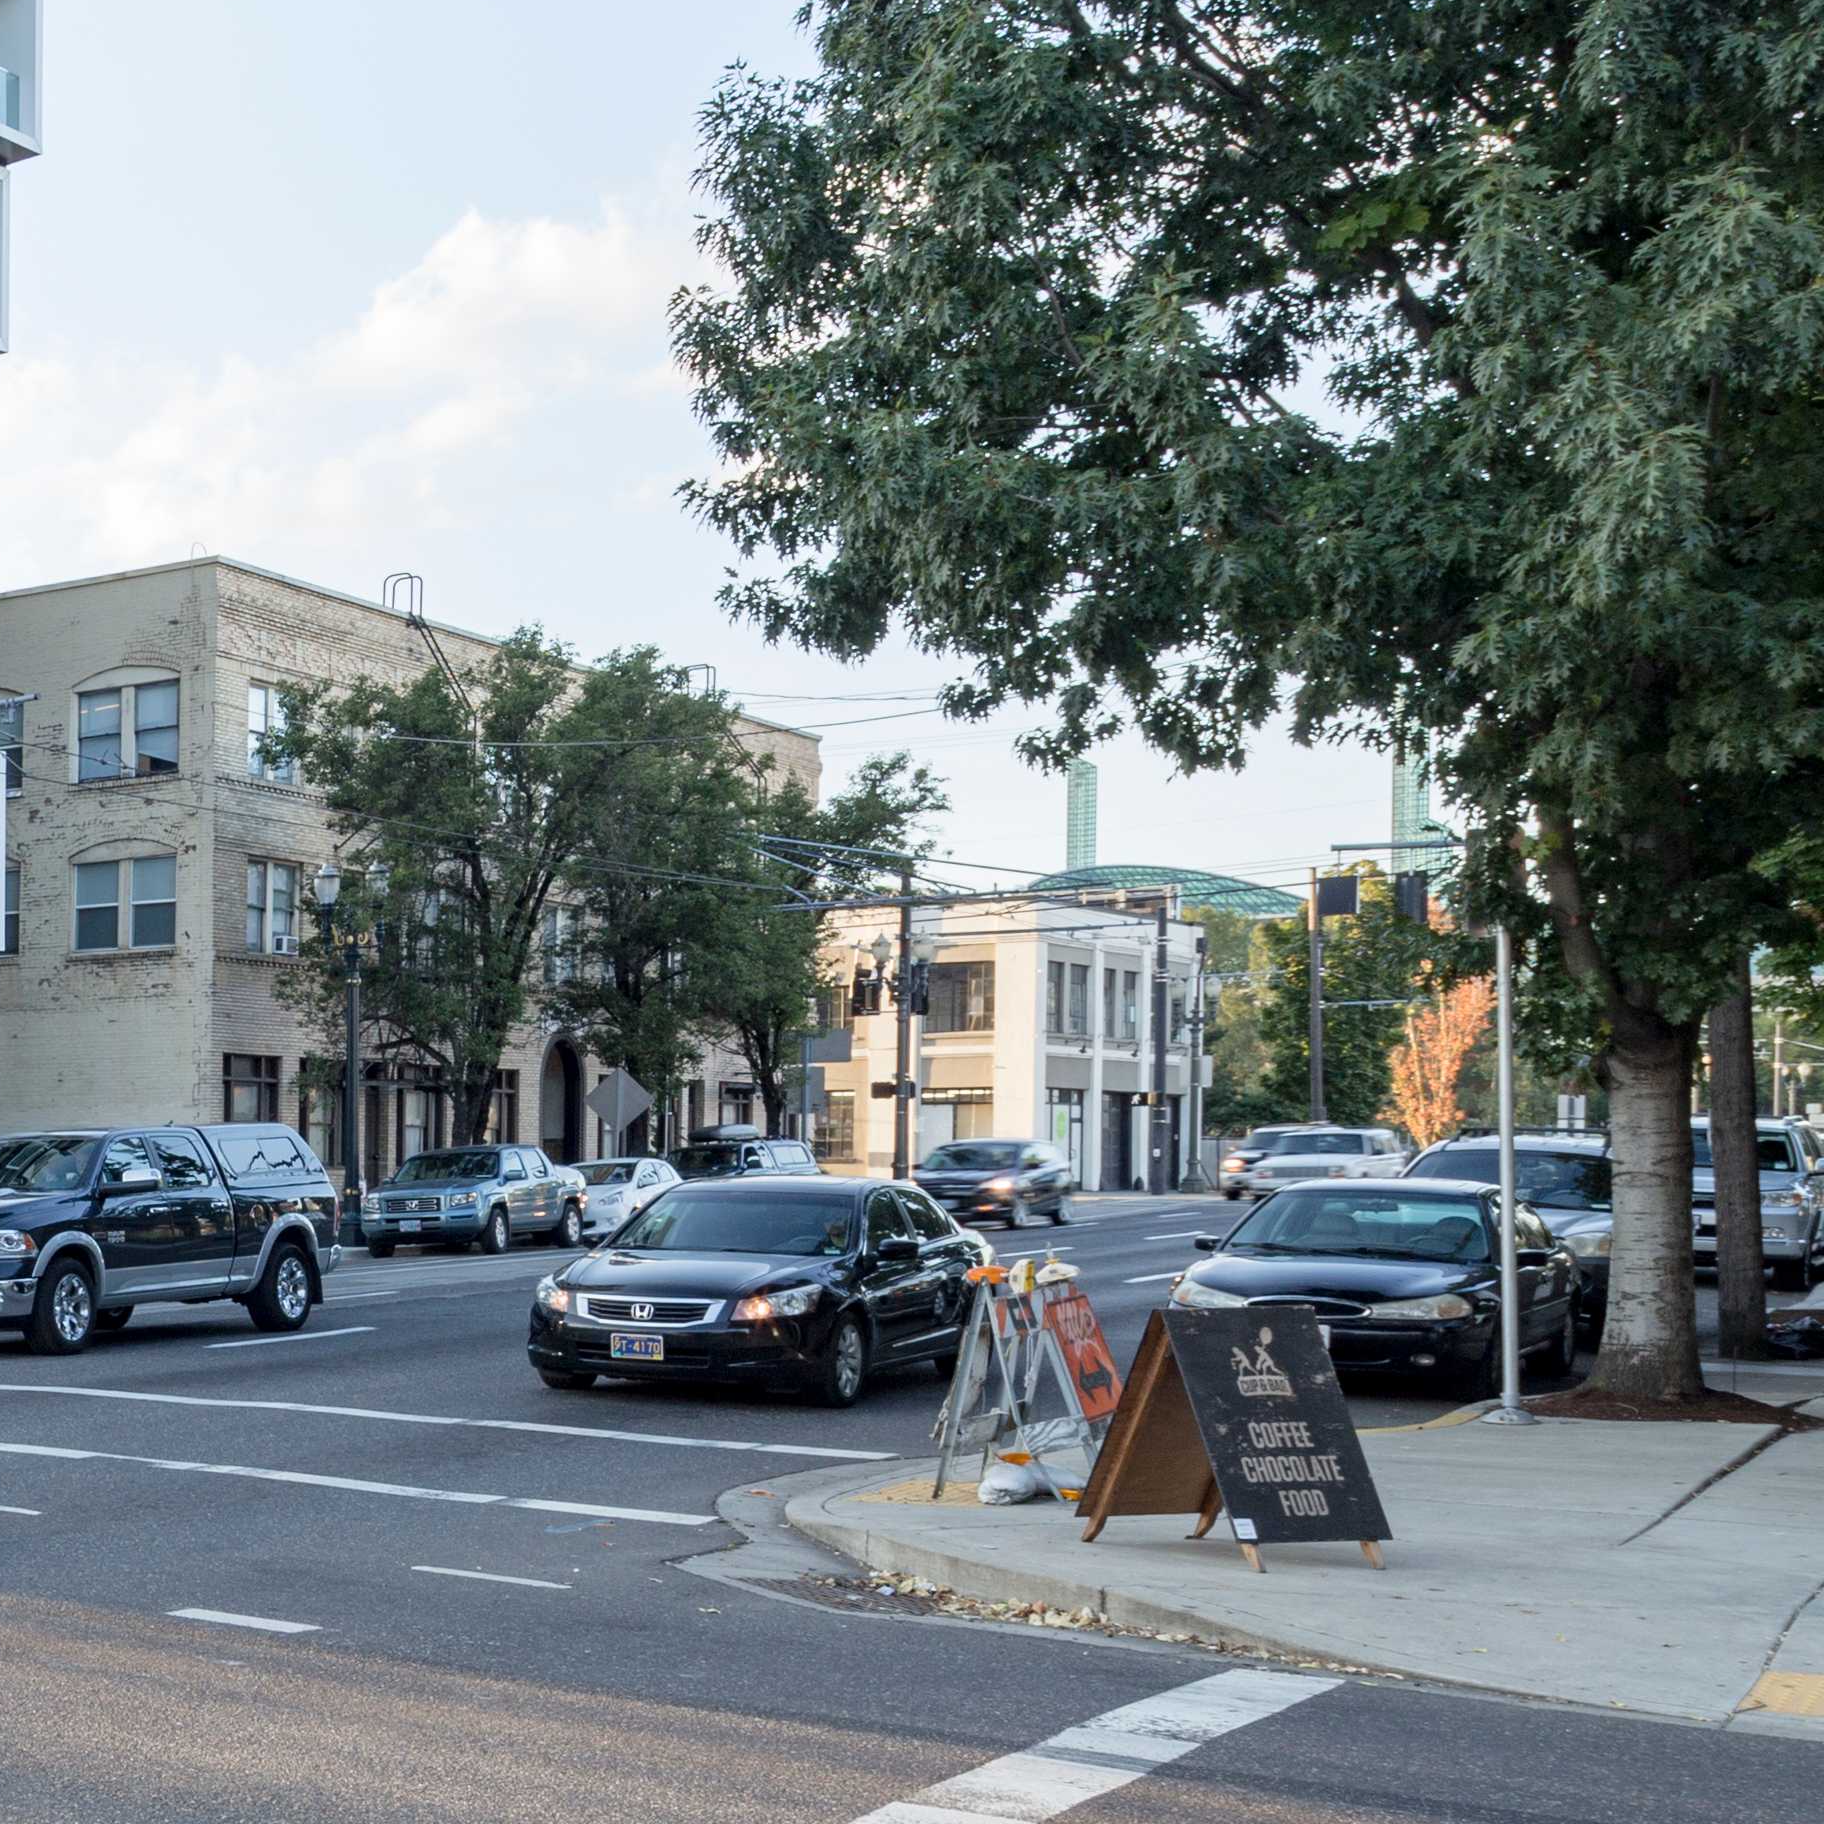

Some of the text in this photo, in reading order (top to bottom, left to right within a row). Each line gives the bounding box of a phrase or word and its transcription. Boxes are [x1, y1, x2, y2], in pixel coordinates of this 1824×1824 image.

[1248, 1422, 1315, 1449] COFFEE
[1240, 1456, 1345, 1483] CHOCOLATE
[1278, 1489, 1330, 1517] FOOD
